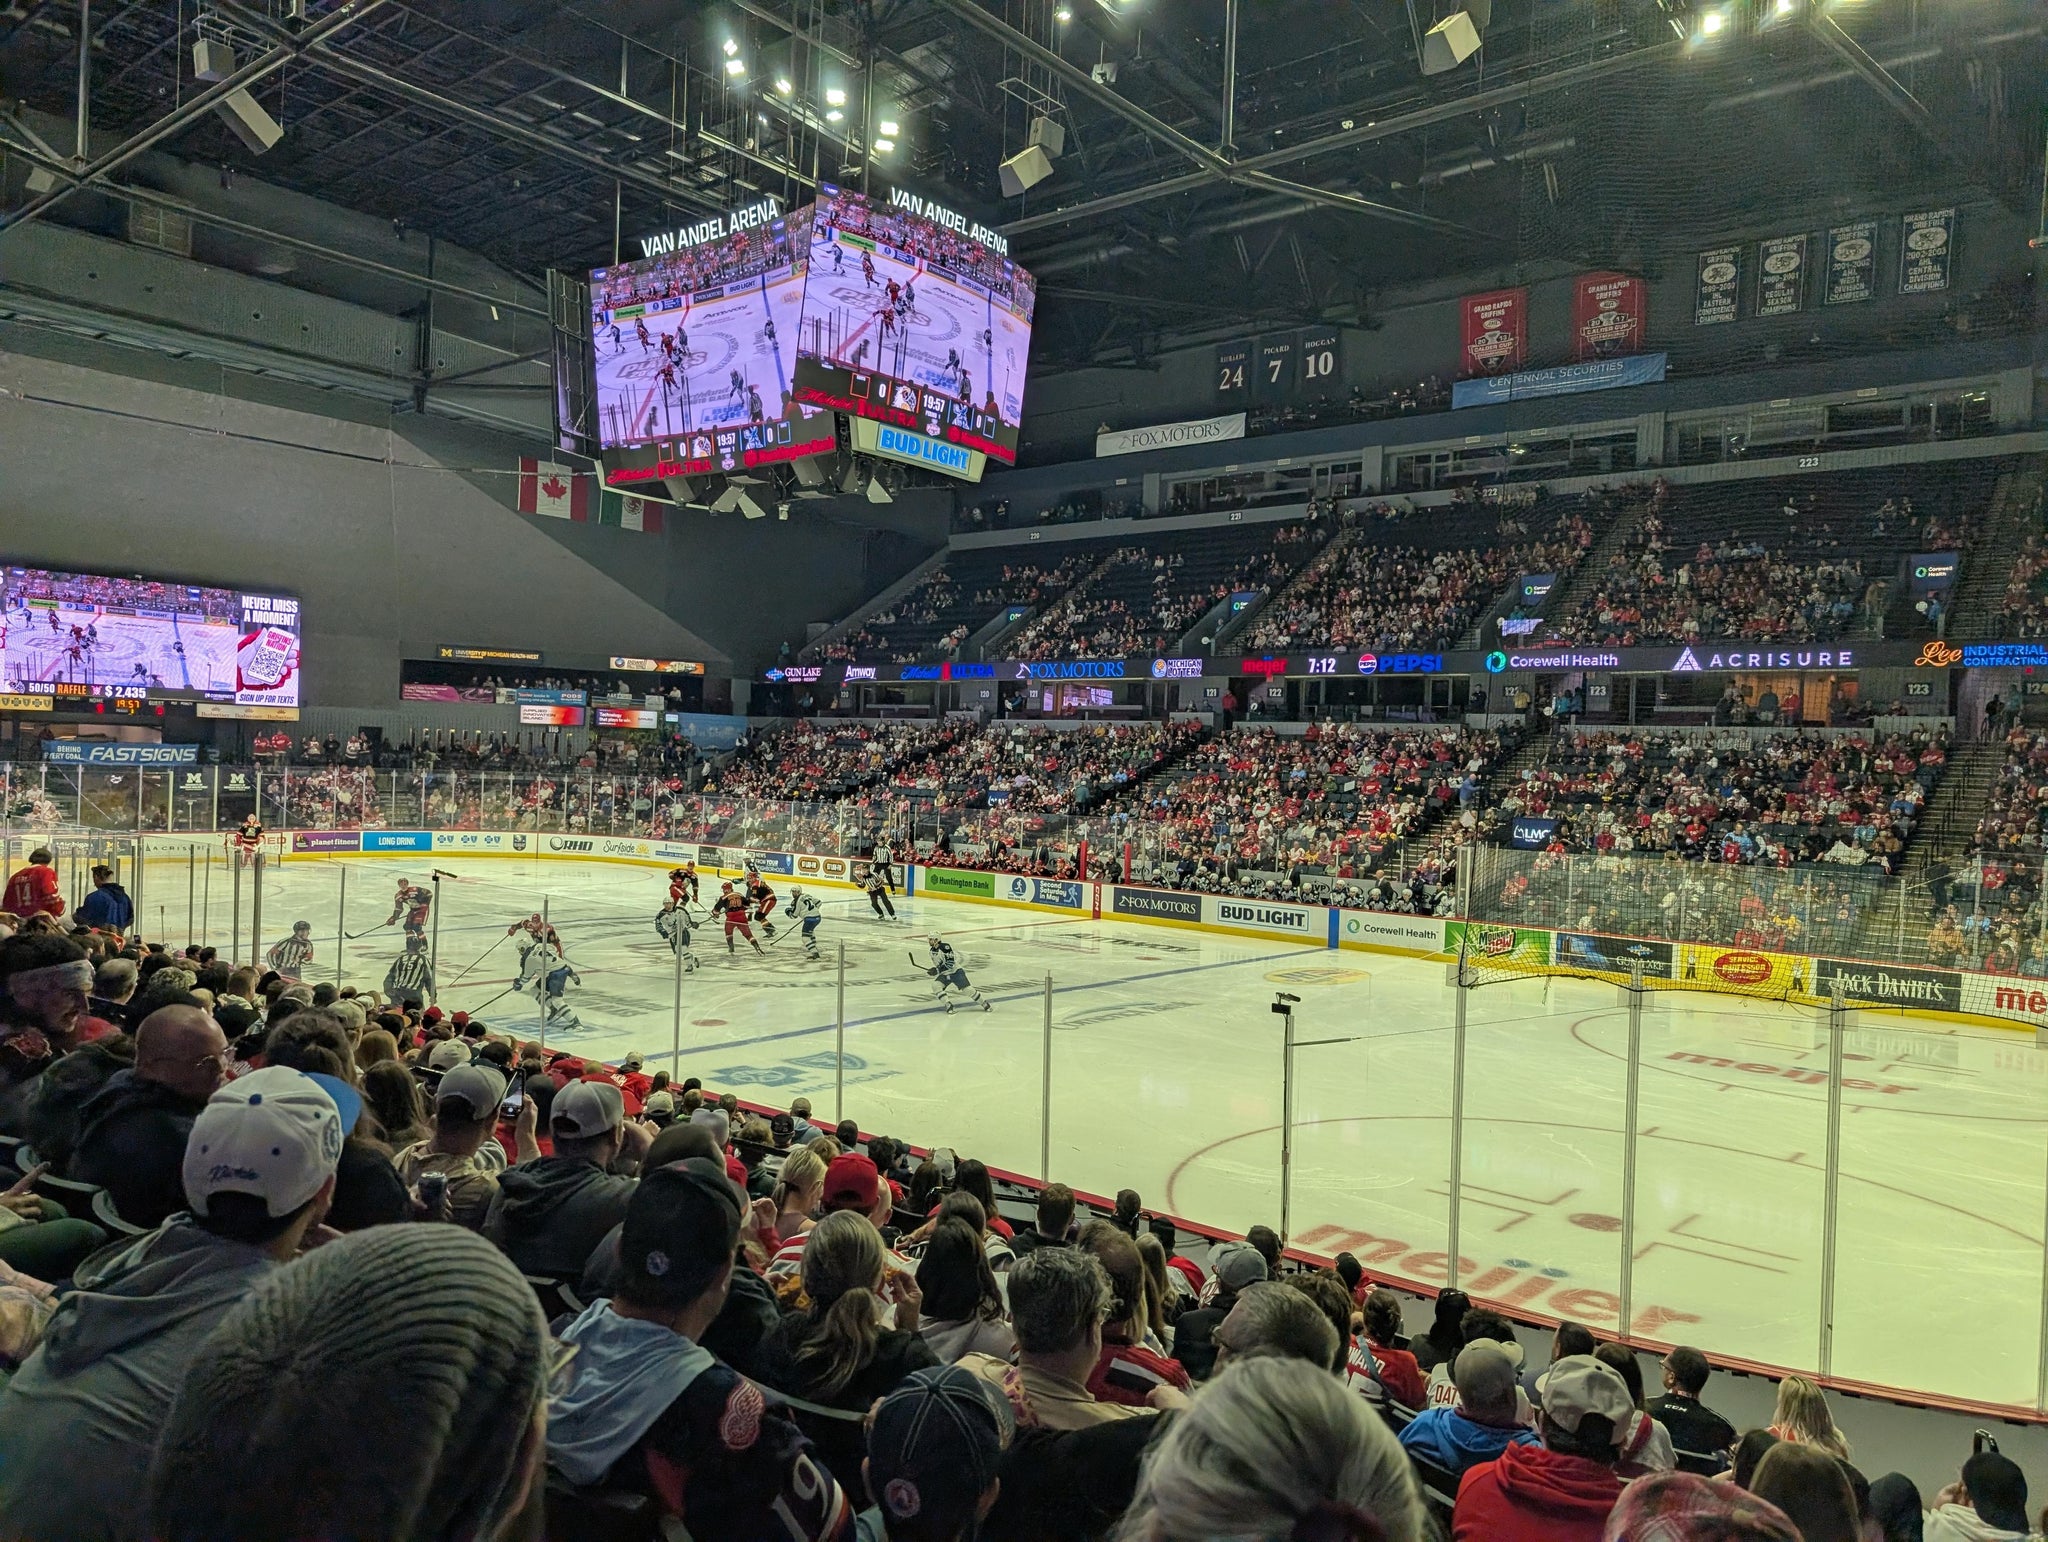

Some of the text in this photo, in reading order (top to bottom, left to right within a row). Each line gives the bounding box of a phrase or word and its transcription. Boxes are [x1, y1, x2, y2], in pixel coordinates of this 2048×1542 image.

[891, 186, 1008, 256] VAN ANDEL ARENA
[1912, 218, 1945, 229] GRIFFINS
[641, 198, 779, 258] VAN ANDEL ARENA
[1906, 247, 1947, 260] 2002-2003
[1908, 265, 1942, 275] CENTRAL
[1909, 272, 1941, 283] DIVISION
[1588, 280, 1630, 293] GRAND RAPIDS
[1904, 280, 1945, 291] CHAMPIONS
[1596, 290, 1622, 300] GRIFFINS
[1474, 300, 1513, 313] GRAND RAPIDS
[1481, 309, 1505, 319] GRIFFINS
[1305, 337, 1336, 349] HOGGAN
[1264, 345, 1290, 355] PICARD
[1306, 351, 1334, 378] 10
[1219, 365, 1244, 390] 24
[1269, 360, 1282, 383] 7
[1488, 361, 1624, 389] CENTENNIAL SECURITIES
[878, 384, 982, 428] 0 19:57 0
[1131, 422, 1220, 448] FOX MOTORS
[679, 427, 774, 457] 0 19:57 0
[881, 429, 920, 456] BUD
[922, 438, 970, 471] LIGHT
[1799, 457, 1819, 467] 223
[242, 596, 298, 613] NEVER MISS
[244, 610, 295, 626] A MOMENT
[267, 631, 292, 645] GRIFFINS
[266, 639, 287, 652] NATION
[1963, 645, 2048, 656] INDUSTRIAL
[1710, 651, 1853, 667] ACRISURE
[1915, 641, 1962, 667] Lee
[1167, 659, 1203, 668] MICHIGAN
[1308, 658, 1336, 673] 7:12
[1379, 655, 1443, 672] PEPSI
[1510, 654, 1618, 668] Corewell Health
[1963, 657, 2048, 667] CONTRACTING
[785, 667, 821, 677] GUN LAKE
[846, 665, 876, 679] Amway
[952, 664, 996, 679] ULTRA
[1030, 662, 1124, 678] FOX MOTORS
[1167, 667, 1202, 677] LOTTERY
[1242, 656, 1288, 681] meijer
[29, 683, 147, 698] 50/50 RAFFLE $ 2,435
[1206, 689, 1217, 697] 121
[1269, 688, 1282, 697] 122
[1590, 686, 1607, 696] 123
[1908, 684, 1930, 695] 123
[115, 699, 140, 709] 19:57
[239, 694, 294, 704] SIGN UP FOR TEXTS
[57, 745, 81, 753] BEHIND
[89, 747, 197, 762] FASTSIGNS
[65, 753, 82, 761] GOAL
[311, 838, 359, 847] planet fitness
[378, 837, 416, 846] LONG DRINK
[603, 840, 635, 854] Surfside
[939, 876, 989, 890] Huntington Bank
[1040, 880, 1062, 889] Second
[1039, 887, 1067, 897] Saturday
[1047, 894, 1060, 903] May
[1130, 896, 1196, 914] FOX MOTORS
[1221, 905, 1305, 927] BUD LIGHT
[1364, 924, 1437, 940] Corewell Health
[1616, 955, 1637, 966] GUN
[1722, 963, 1766, 973] PROFESSOR
[1829, 968, 1945, 1002] JACK DANIEL'S
[1665, 1051, 1918, 1095] meijer
[1290, 1222, 1702, 1335] meijer
